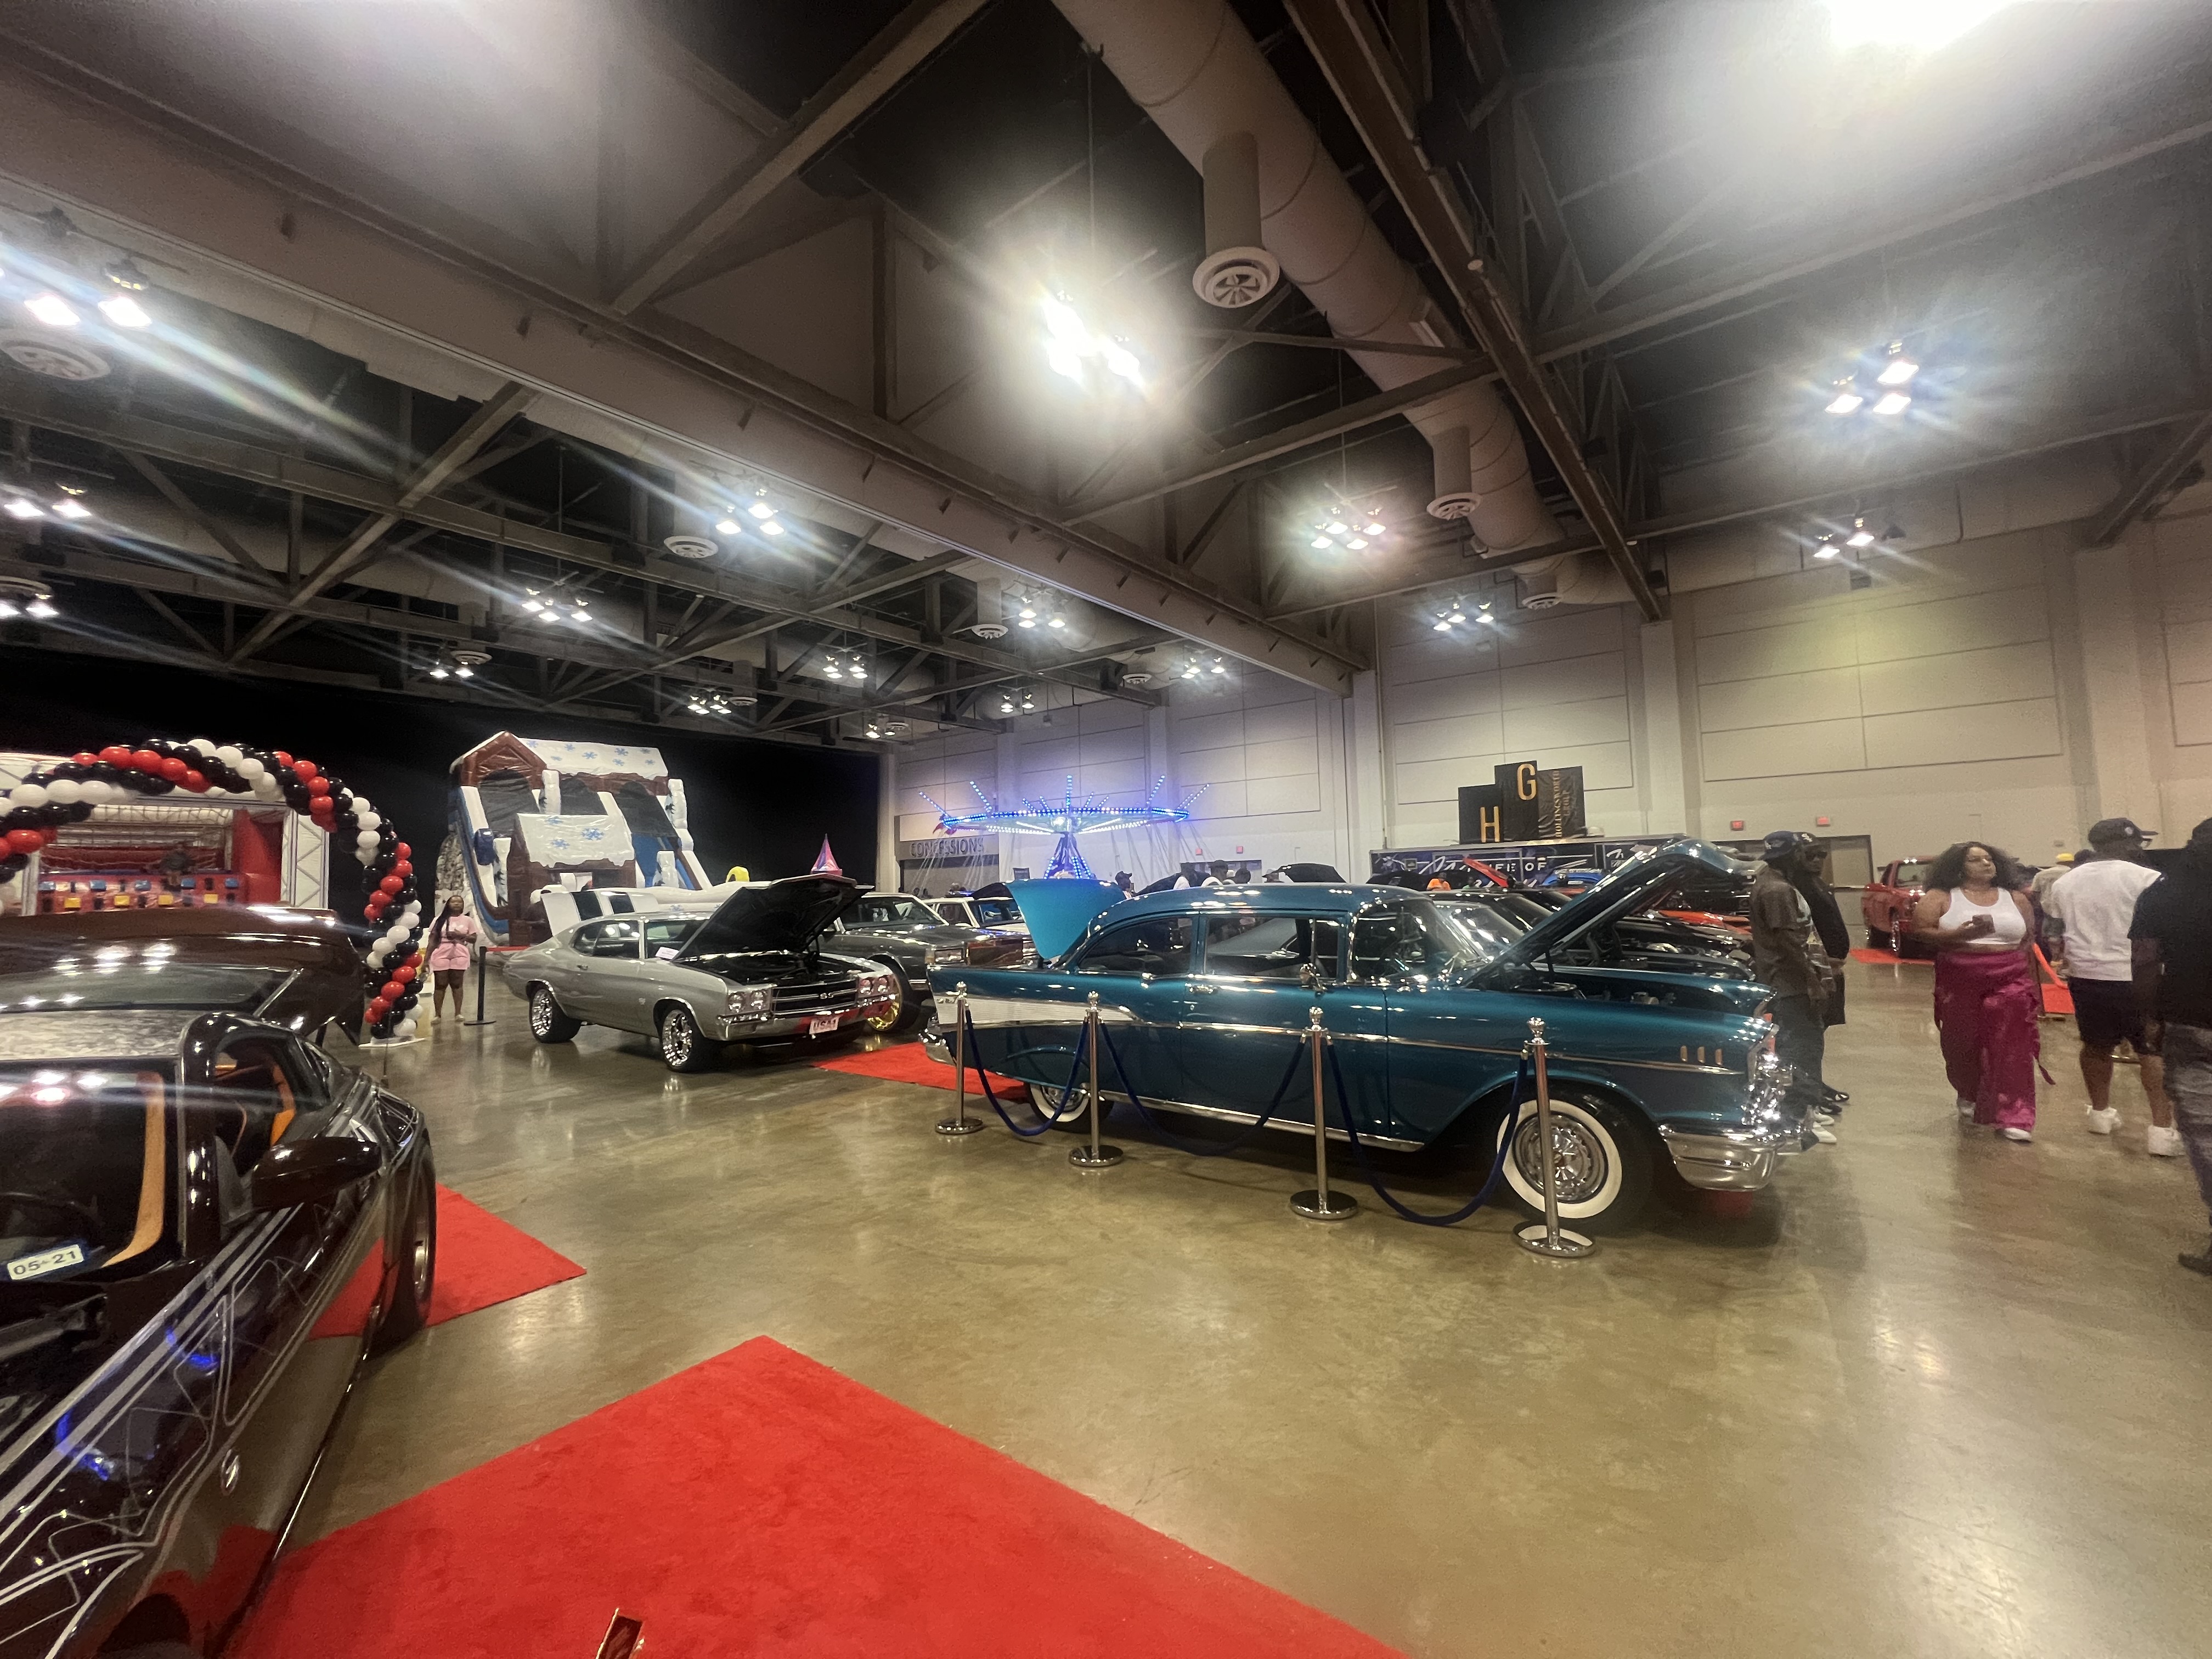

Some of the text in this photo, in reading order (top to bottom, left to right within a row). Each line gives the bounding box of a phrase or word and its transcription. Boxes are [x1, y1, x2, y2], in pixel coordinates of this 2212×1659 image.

[1517, 763, 1537, 800] G
[1480, 806, 1500, 843] H
[911, 838, 984, 857] CONCESSIONS
[1525, 862, 1547, 871] OF
